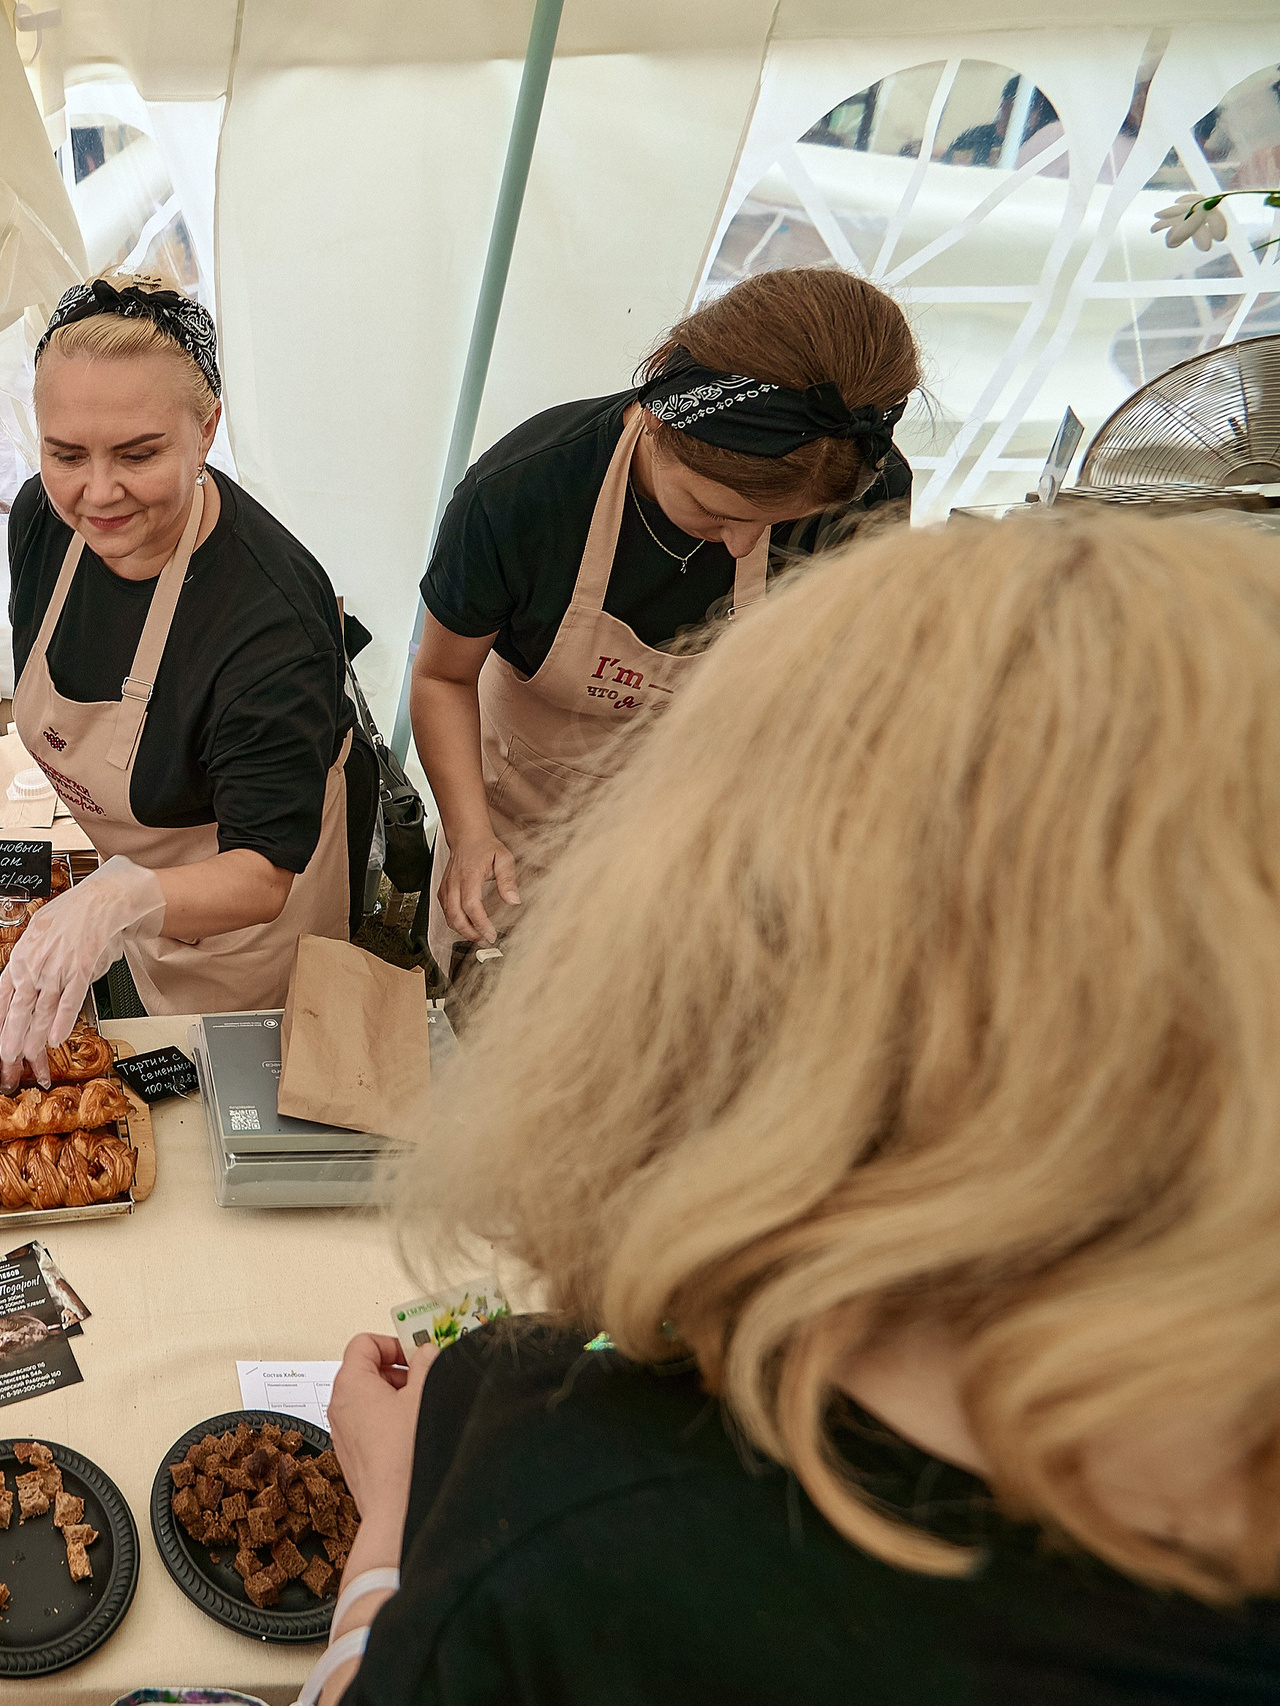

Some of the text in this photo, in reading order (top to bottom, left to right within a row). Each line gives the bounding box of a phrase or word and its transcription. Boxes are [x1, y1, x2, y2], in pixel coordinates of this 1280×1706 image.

[591, 656, 644, 690] I'm
[116, 1055, 169, 1076] Тартин
[140, 1061, 192, 1082] семенами
